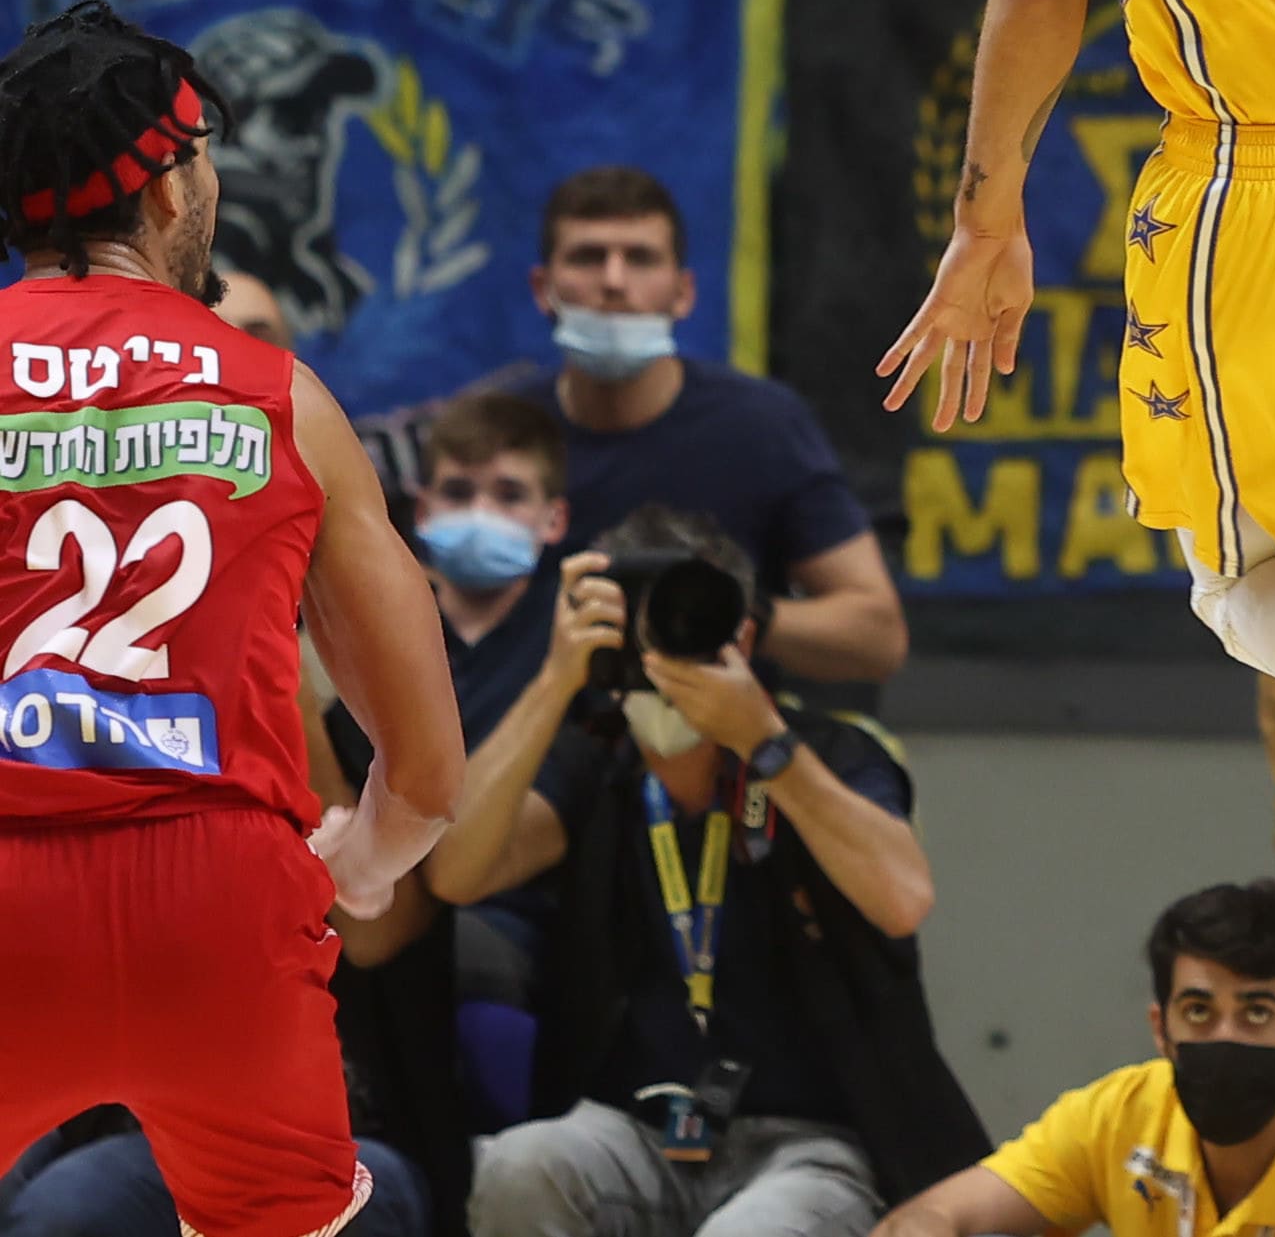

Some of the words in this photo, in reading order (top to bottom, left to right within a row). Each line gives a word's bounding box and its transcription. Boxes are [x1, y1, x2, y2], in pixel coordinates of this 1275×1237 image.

[11, 335, 221, 401] גייטס
[114, 407, 266, 477] תלפיות
[3, 499, 214, 683] 22
